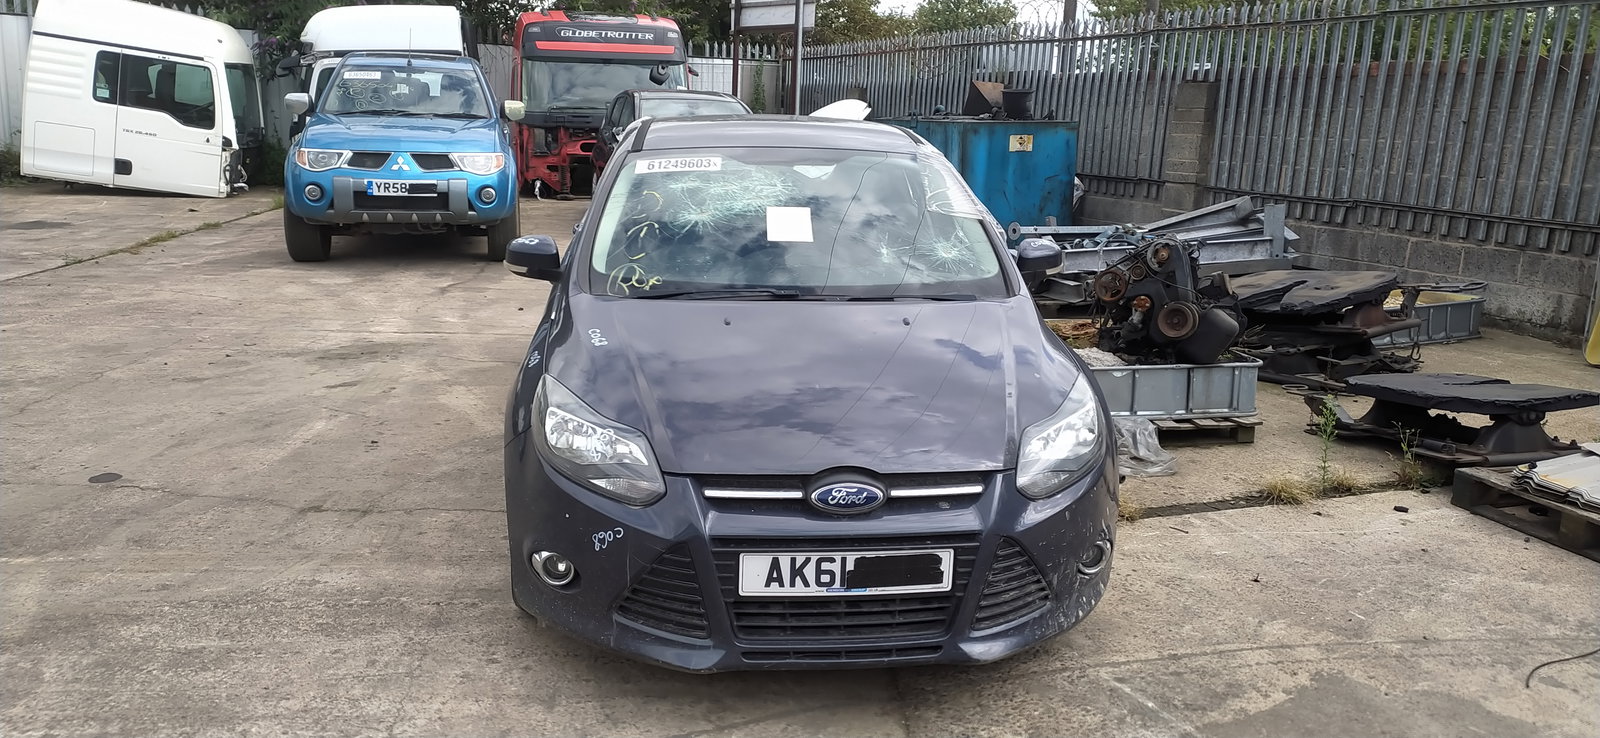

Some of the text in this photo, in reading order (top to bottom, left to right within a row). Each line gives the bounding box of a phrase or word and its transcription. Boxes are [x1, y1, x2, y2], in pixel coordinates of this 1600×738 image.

[560, 30, 654, 40] GLOBETROTTER
[375, 182, 408, 194] YR58
[828, 488, 867, 504] Ford
[764, 557, 847, 588] AK61
